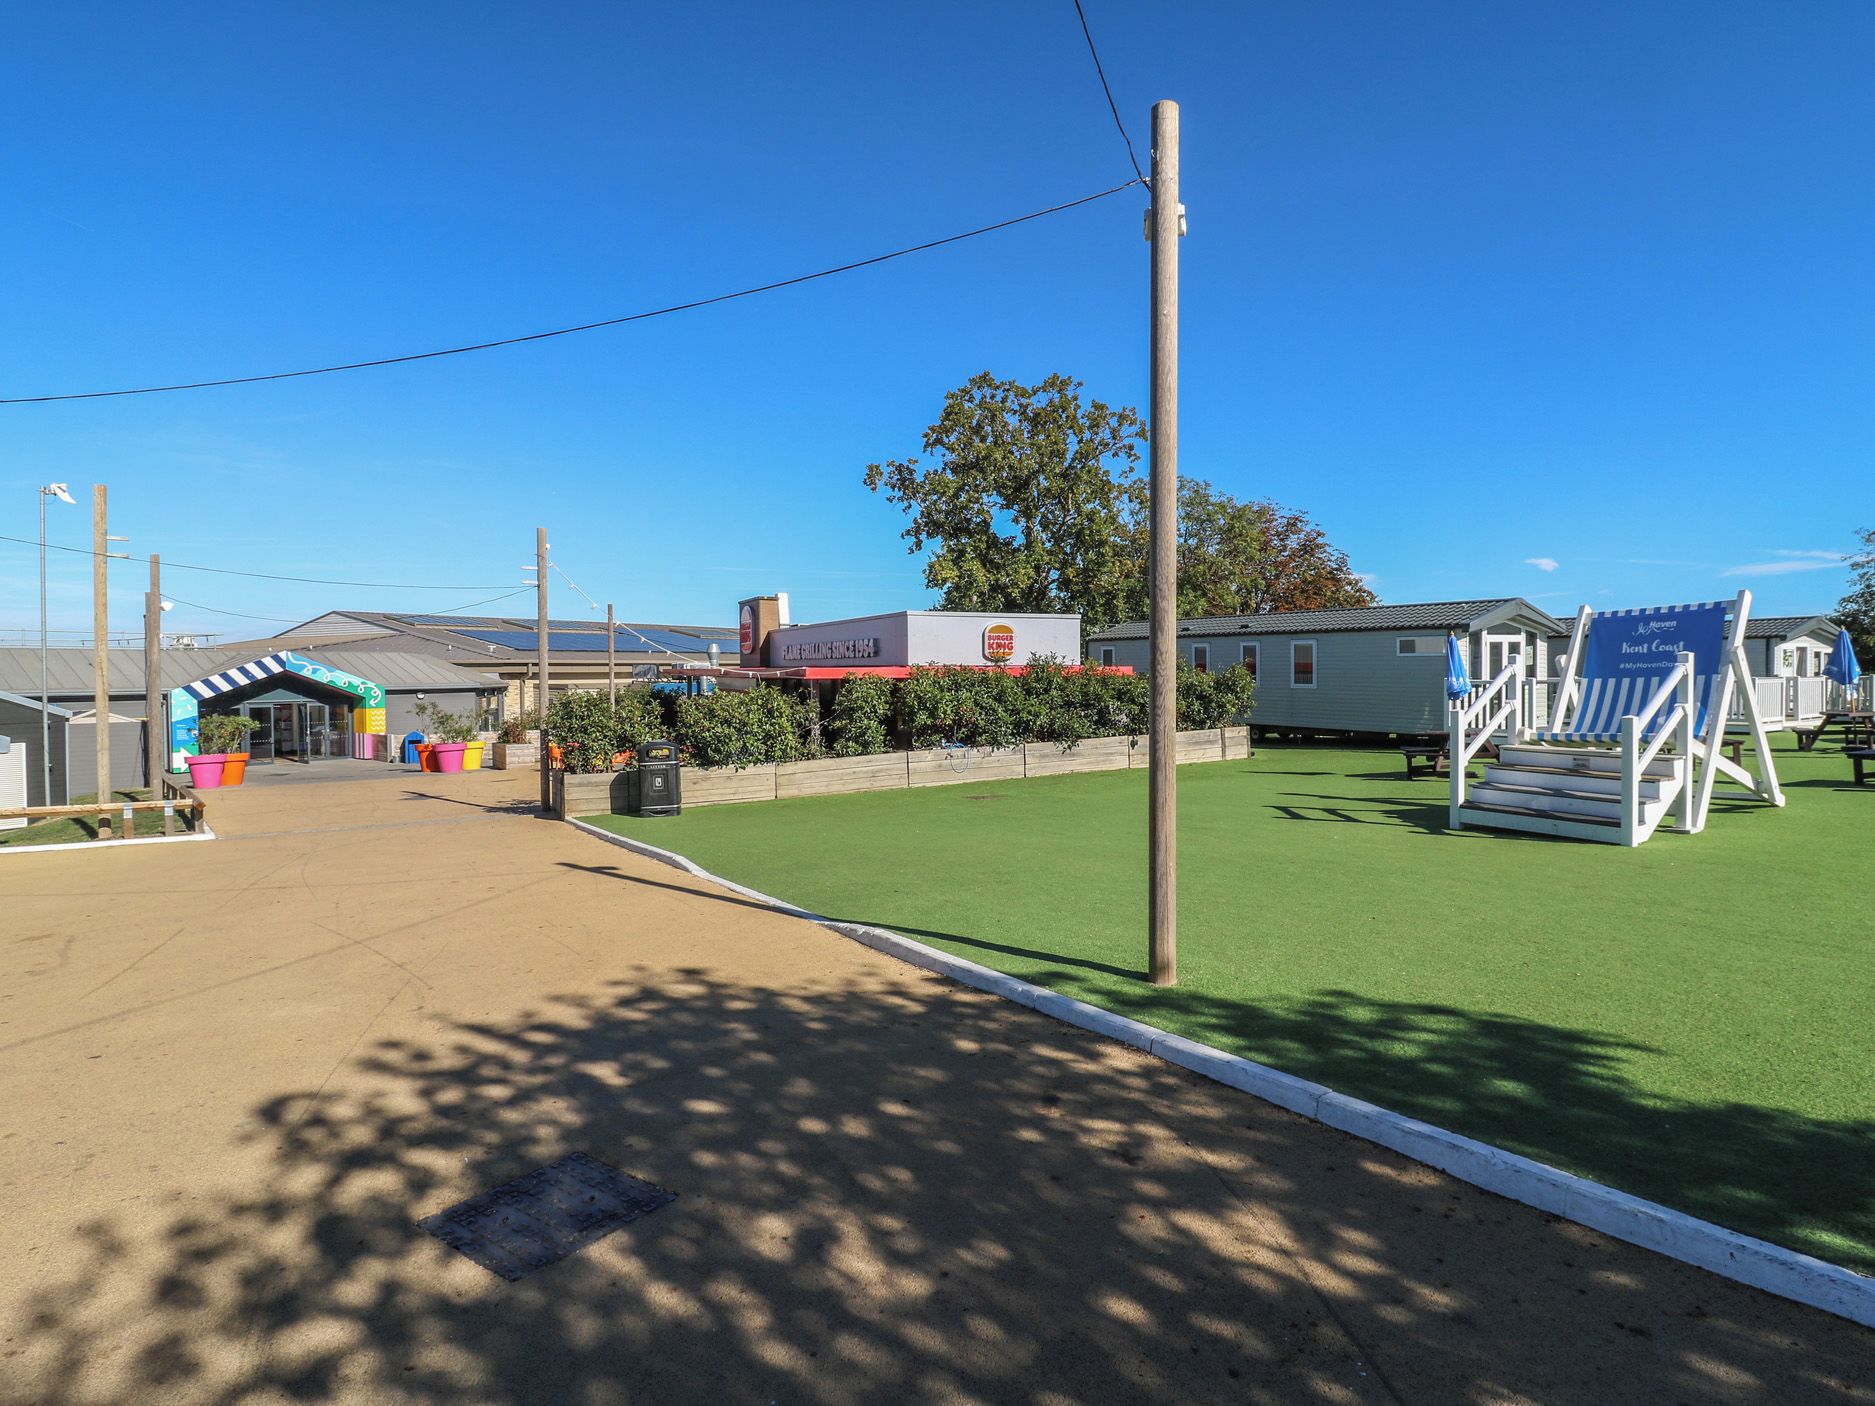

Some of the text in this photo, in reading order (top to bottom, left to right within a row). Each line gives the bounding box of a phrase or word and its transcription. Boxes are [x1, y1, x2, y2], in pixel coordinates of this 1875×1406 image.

[801, 642, 832, 660] GRILLING
[832, 640, 855, 659] SINCE
[855, 638, 875, 658] 1954
[987, 642, 1013, 650] KING
[1622, 640, 1684, 655] Kent Coast
